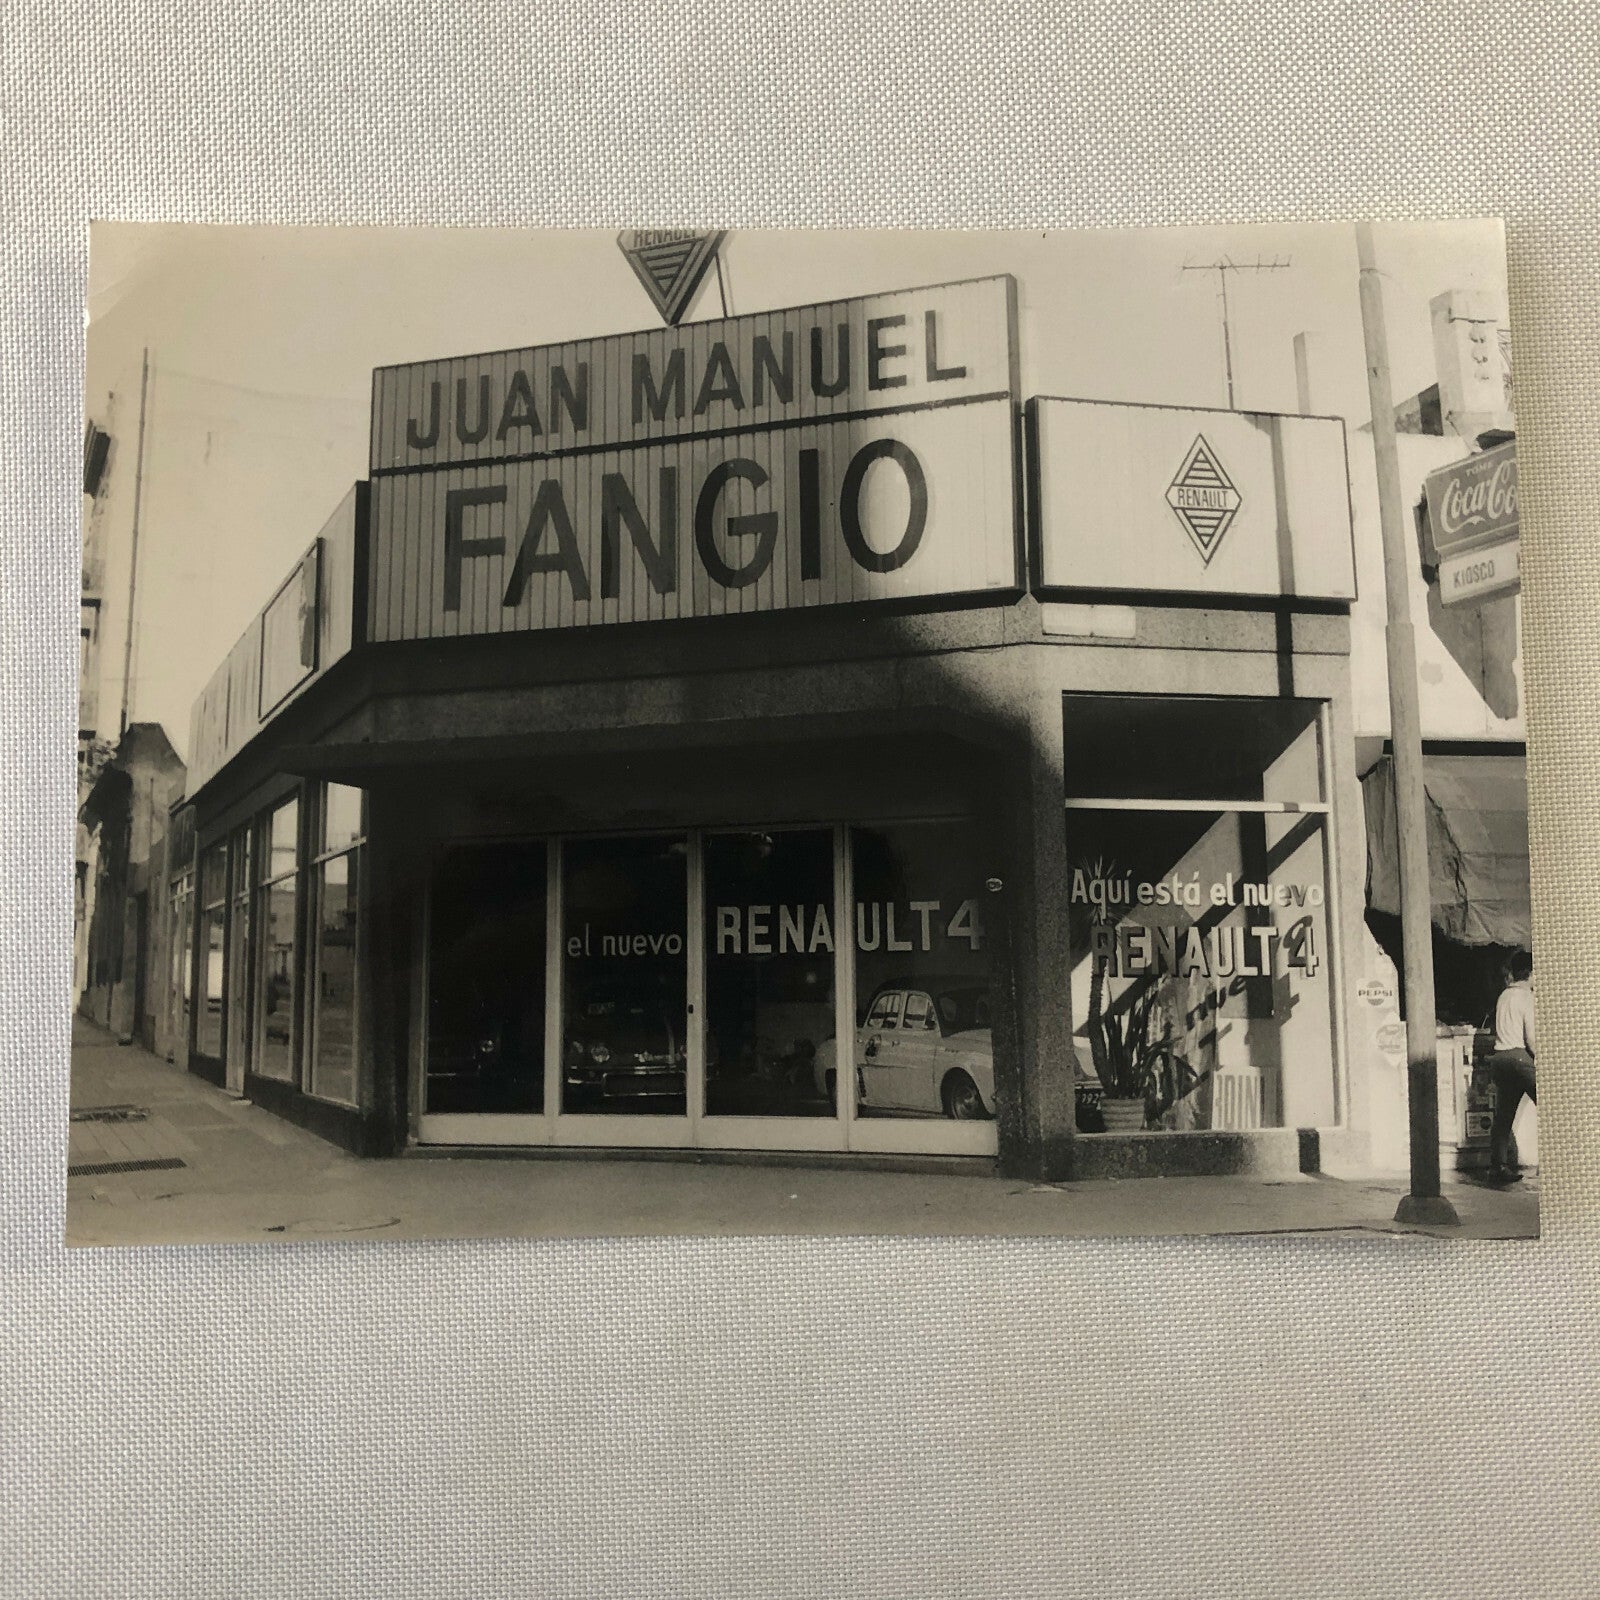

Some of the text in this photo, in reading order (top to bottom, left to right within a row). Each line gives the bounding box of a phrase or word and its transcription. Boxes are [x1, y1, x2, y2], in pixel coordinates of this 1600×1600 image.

[406, 309, 967, 449] JUAN MANUEL
[1177, 488, 1228, 508] RENAULT
[1441, 459, 1520, 533] Coca-Co
[443, 437, 928, 612] FANGIO
[1453, 560, 1495, 588] KIOSCO
[1070, 868, 1324, 920] Aquí está el nuevo
[567, 899, 986, 957] el nuevo RENAULT 4
[1092, 925, 1319, 978] RENAULT 4
[1358, 989, 1392, 997] PEPSI
